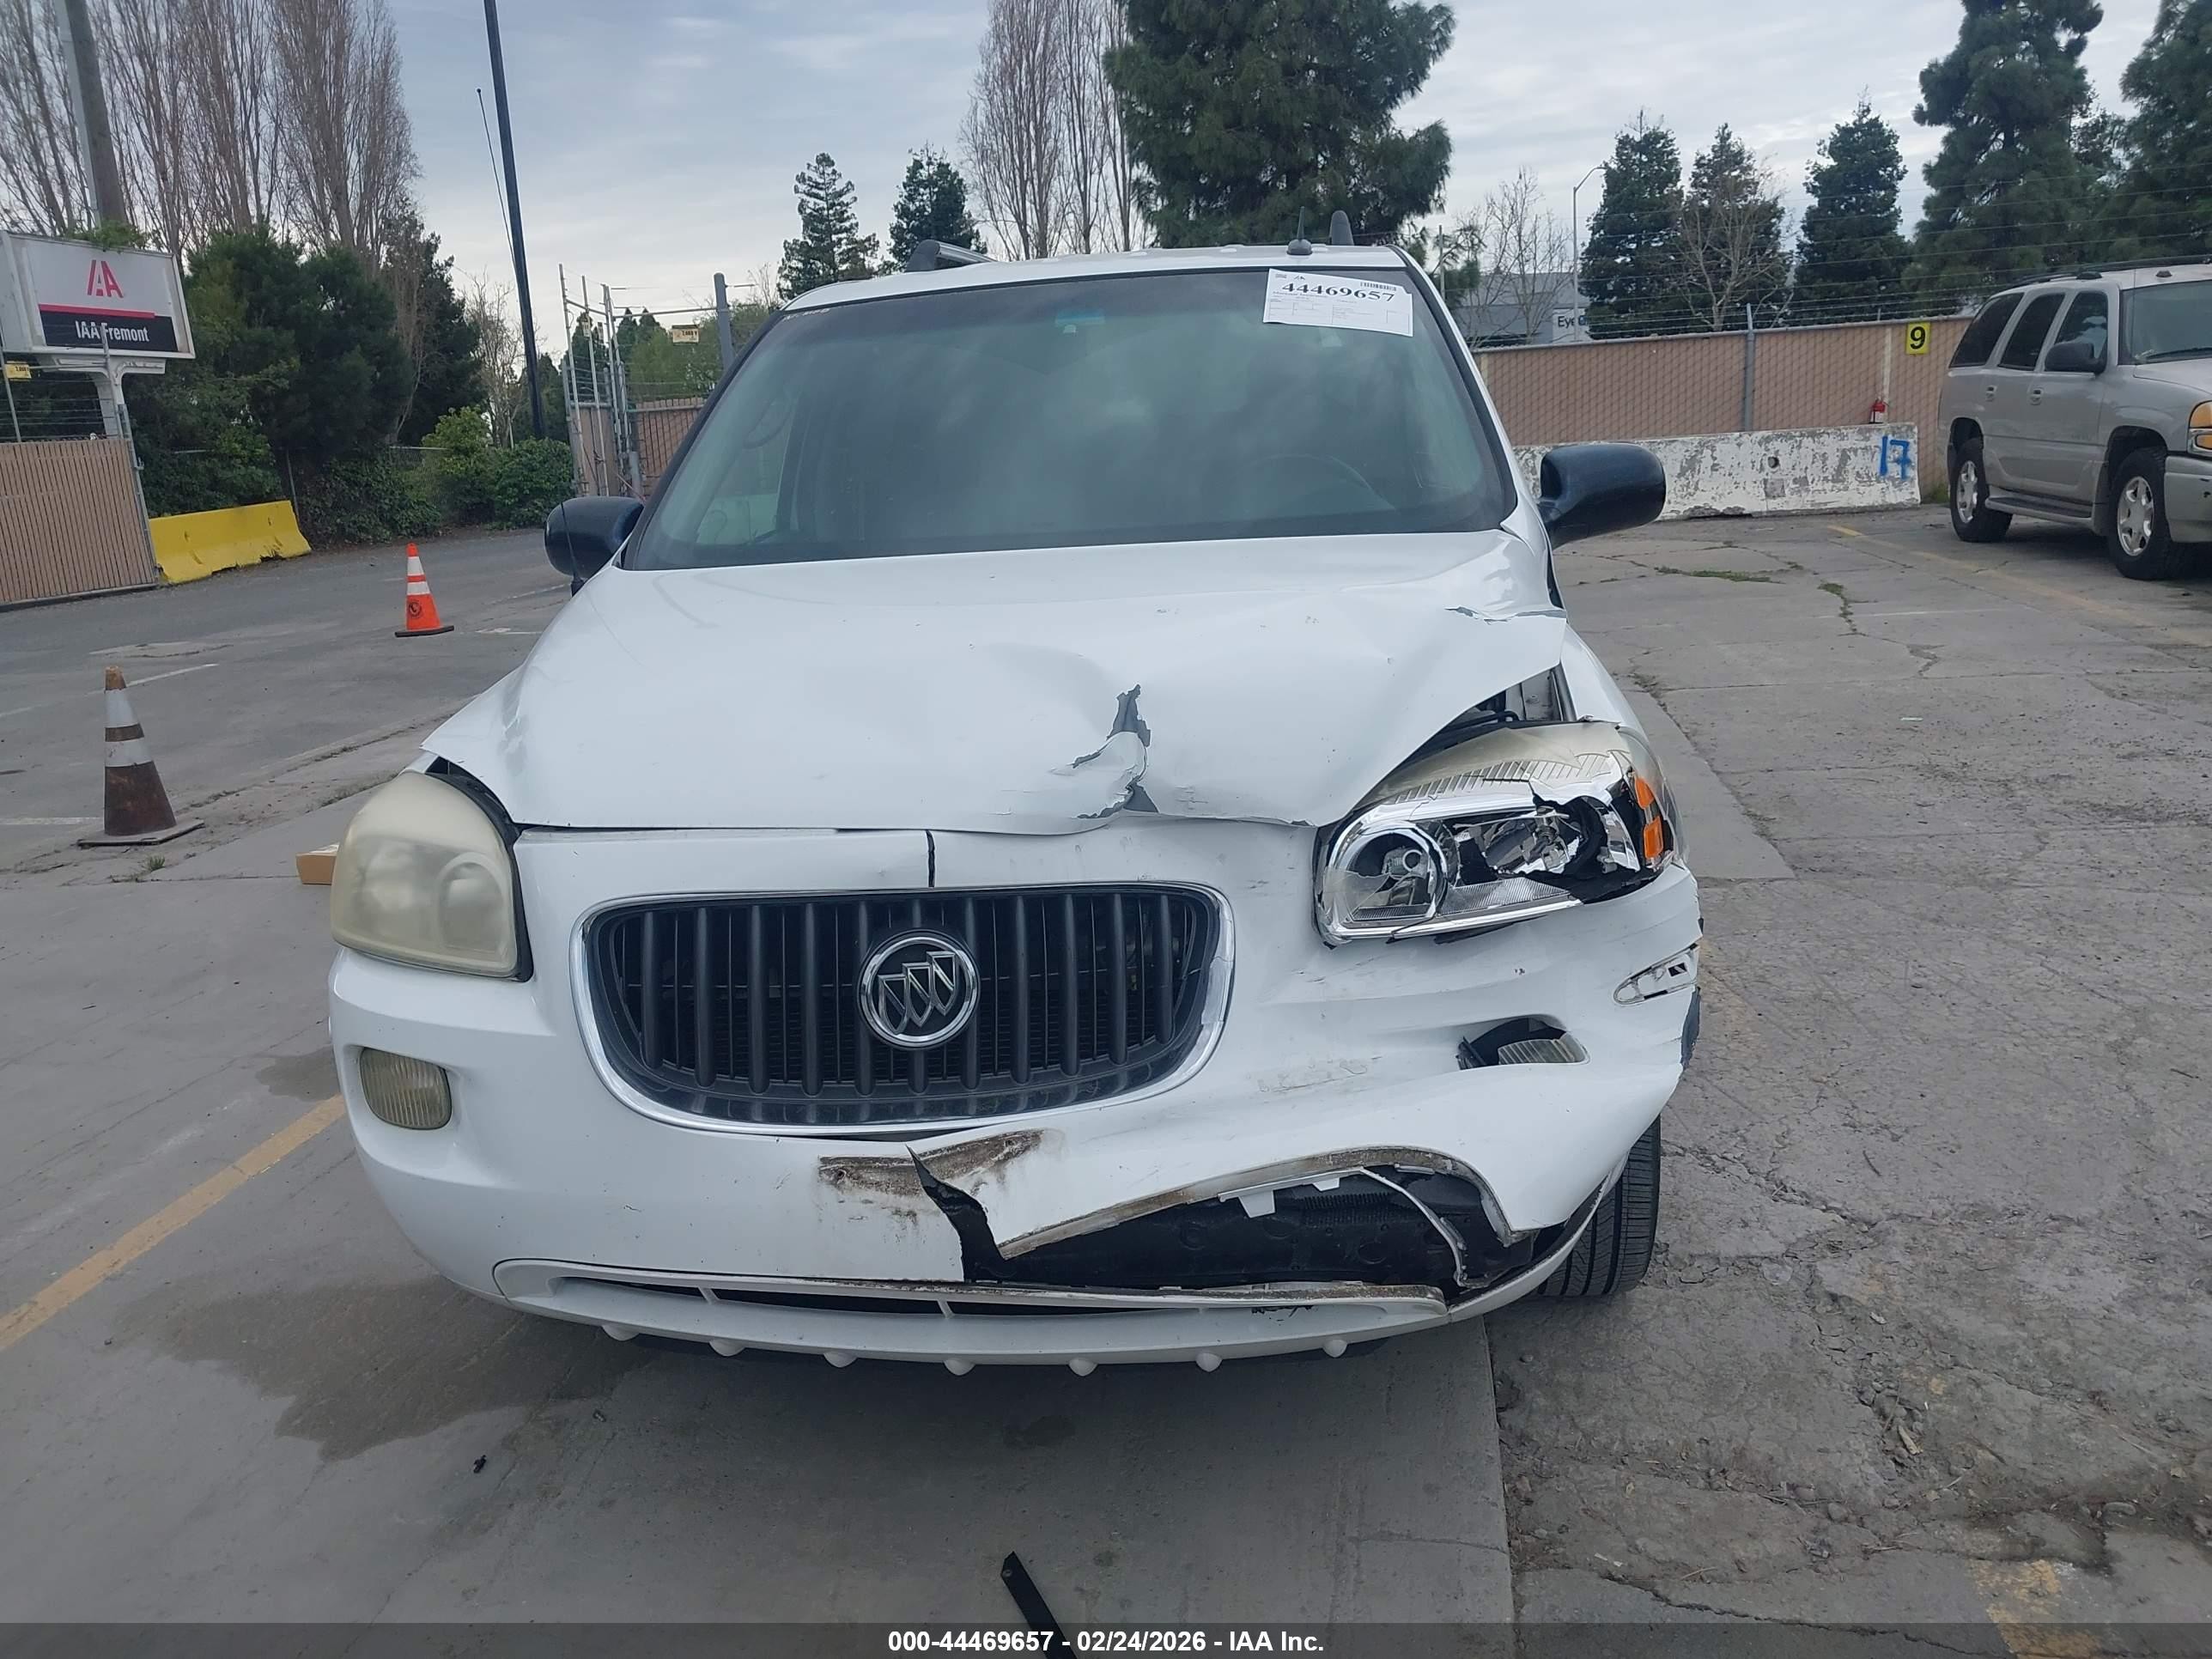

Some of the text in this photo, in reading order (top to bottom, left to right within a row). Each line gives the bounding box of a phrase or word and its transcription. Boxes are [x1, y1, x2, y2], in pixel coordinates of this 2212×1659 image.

[1281, 283, 1395, 302] 44469657
[75, 320, 150, 342] IAA Fremont
[1910, 326, 1926, 349] 9
[1879, 435, 1911, 481] 17
